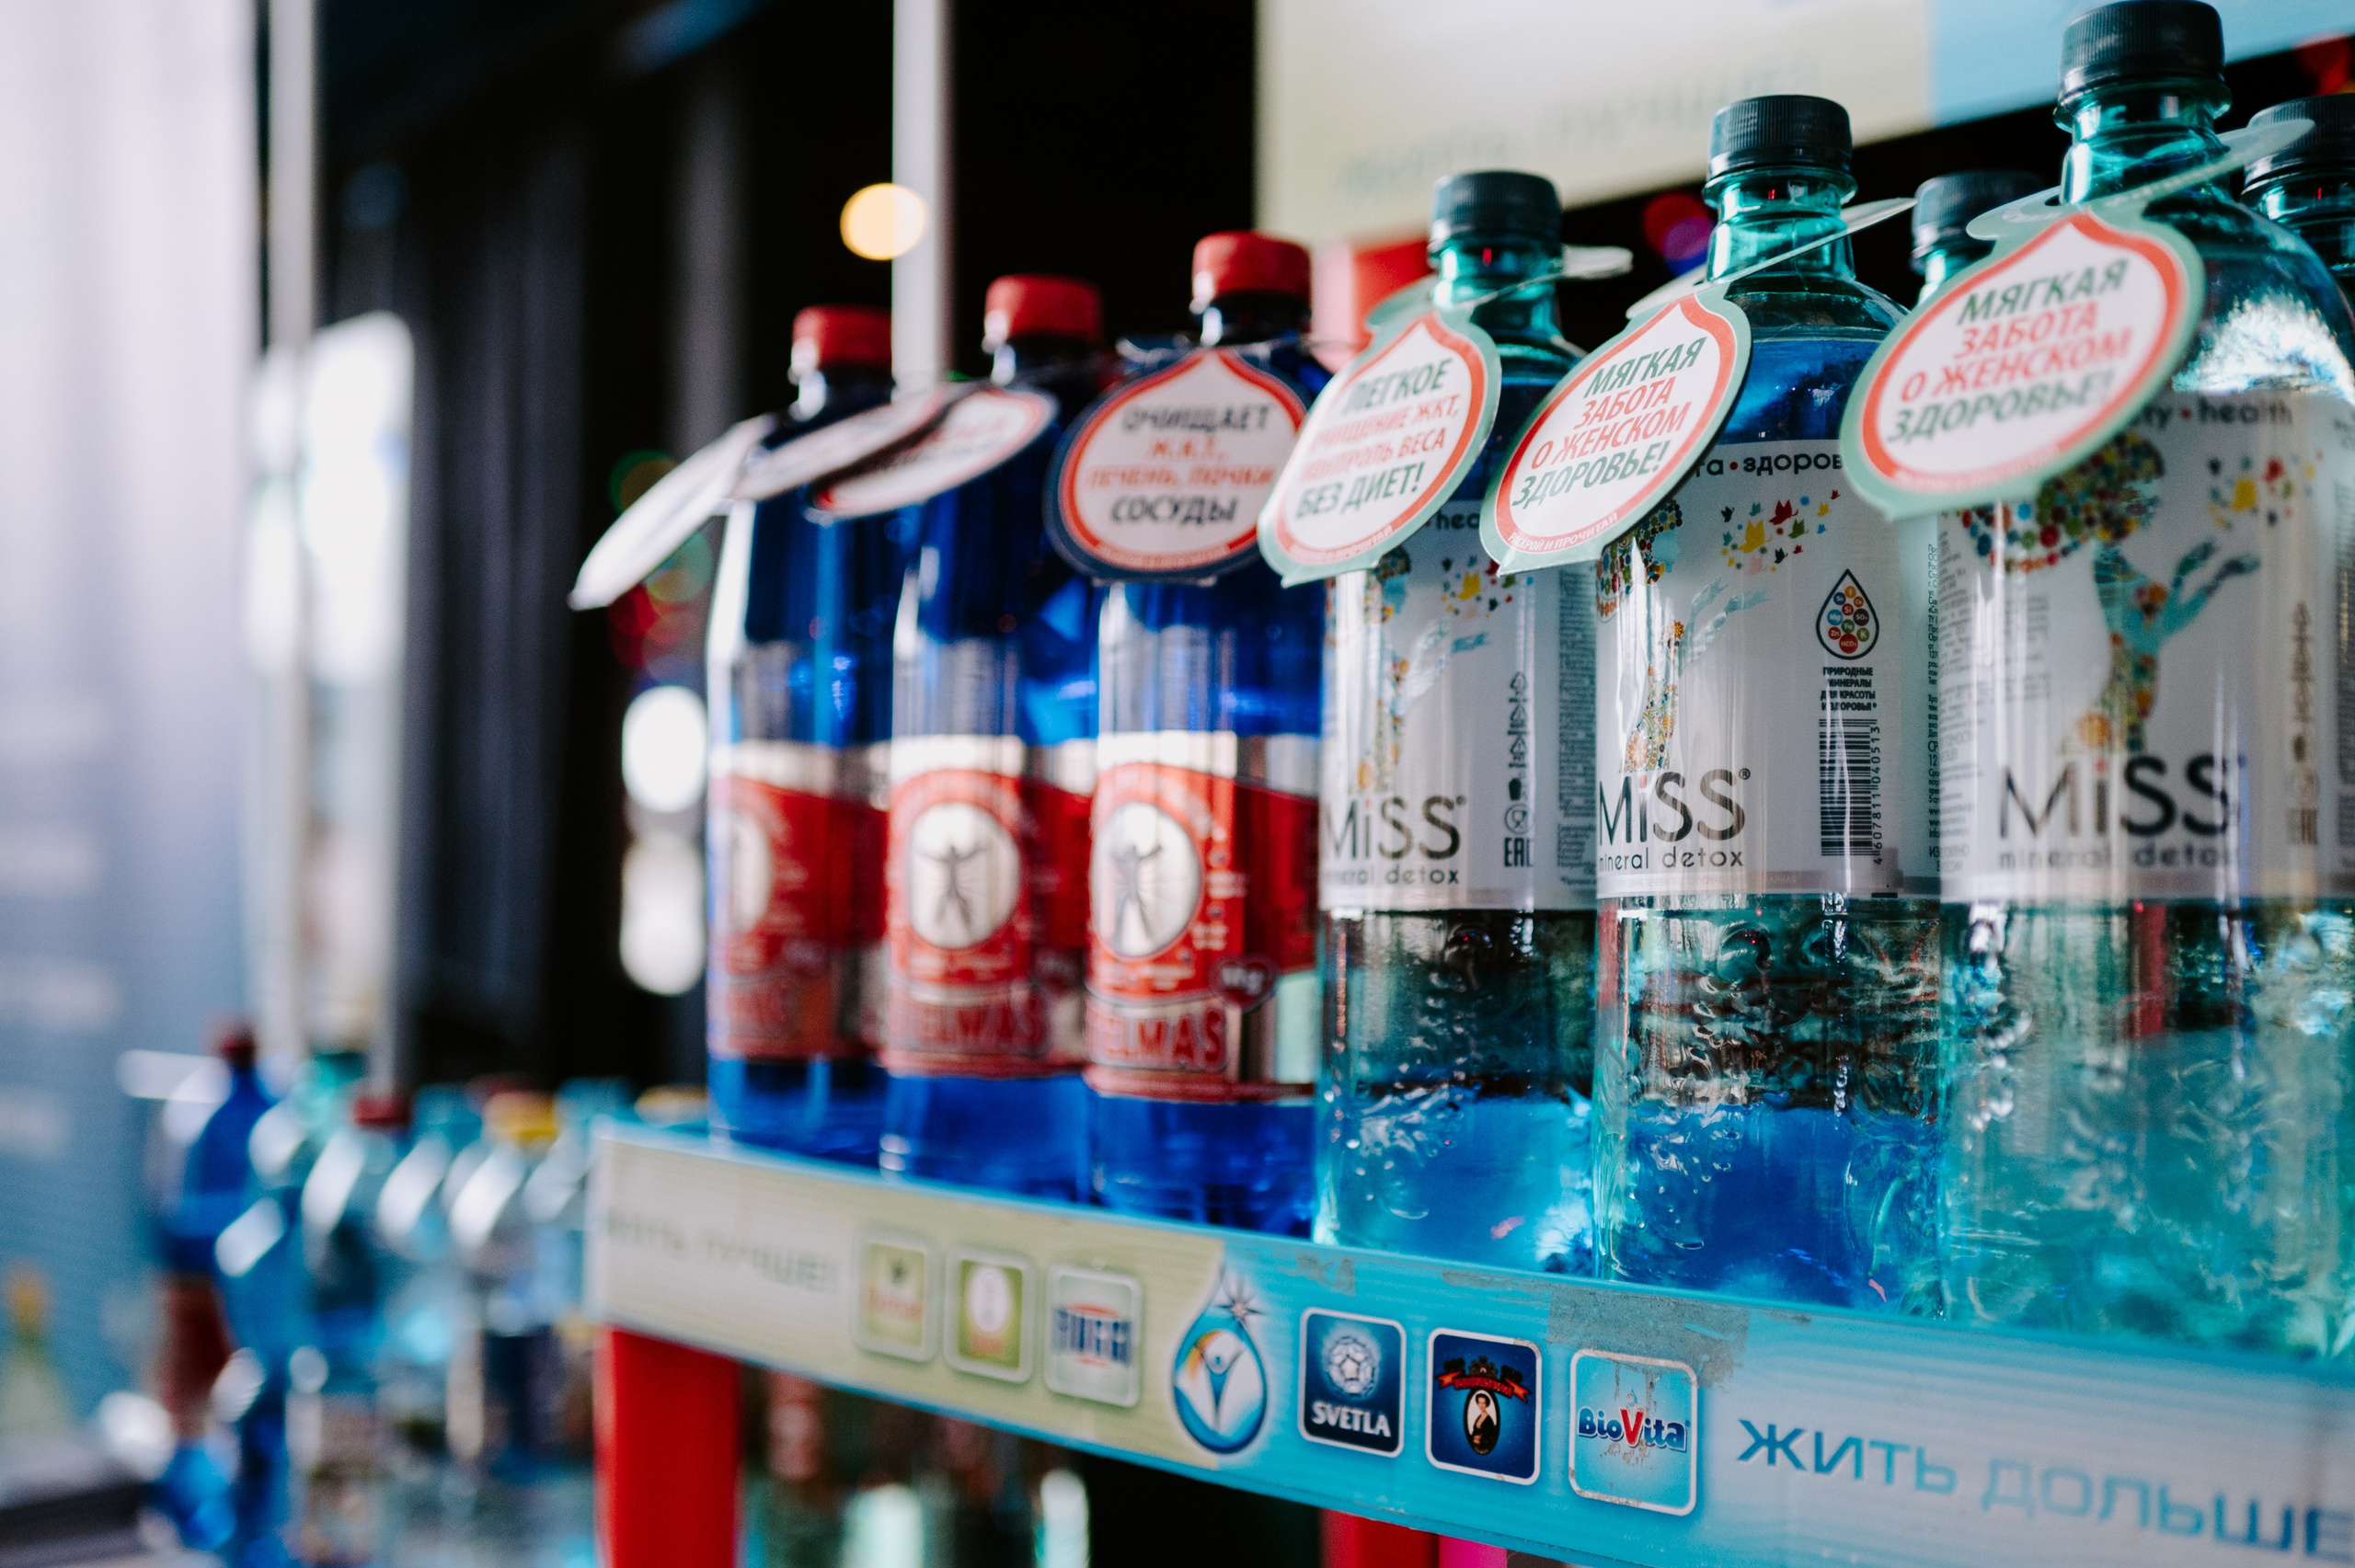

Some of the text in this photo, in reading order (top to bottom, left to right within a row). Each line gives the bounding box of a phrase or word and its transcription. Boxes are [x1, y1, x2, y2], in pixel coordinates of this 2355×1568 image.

[1957, 258, 2131, 326] МЯГКАЯ
[1953, 300, 2099, 361] ЗАБОТА
[1343, 358, 1453, 414] ЛЕГКОЕ
[1583, 336, 1708, 398] МЯГКАЯ
[1901, 327, 2132, 403] О ЖЕНСКОМ
[1121, 404, 1270, 433] ОЧИЩАЕТ
[1573, 376, 1677, 429] ЗАБОТА
[1888, 370, 2116, 444] ЗДОРОВЬЕ!
[1397, 427, 1447, 459] ВЕСА
[1531, 401, 1693, 470] О ЖЕНСКОМ
[1295, 461, 1426, 520] БЕЗ ДИЕТ!
[1511, 440, 1671, 509] ЗДОРОВЬЕ!
[1110, 494, 1238, 525] СОСУДЫ
[1508, 511, 1618, 551] РАСКРОЙ И ПРОЧИТАЙ
[1822, 667, 1874, 678] ПРИРОДНЫЕ
[1827, 679, 1872, 688] МИНЕРАЛЫ
[1839, 690, 1876, 700] КРАСОТЫ
[1386, 863, 1459, 885] detox
[1662, 845, 1744, 868] detox
[2134, 841, 2227, 867] deto
[1311, 1399, 1393, 1438] SVETLA
[1578, 1407, 1688, 1453] BioVita
[1736, 1418, 2355, 1563] ЖИТЬ ДОЛЬШЕ
